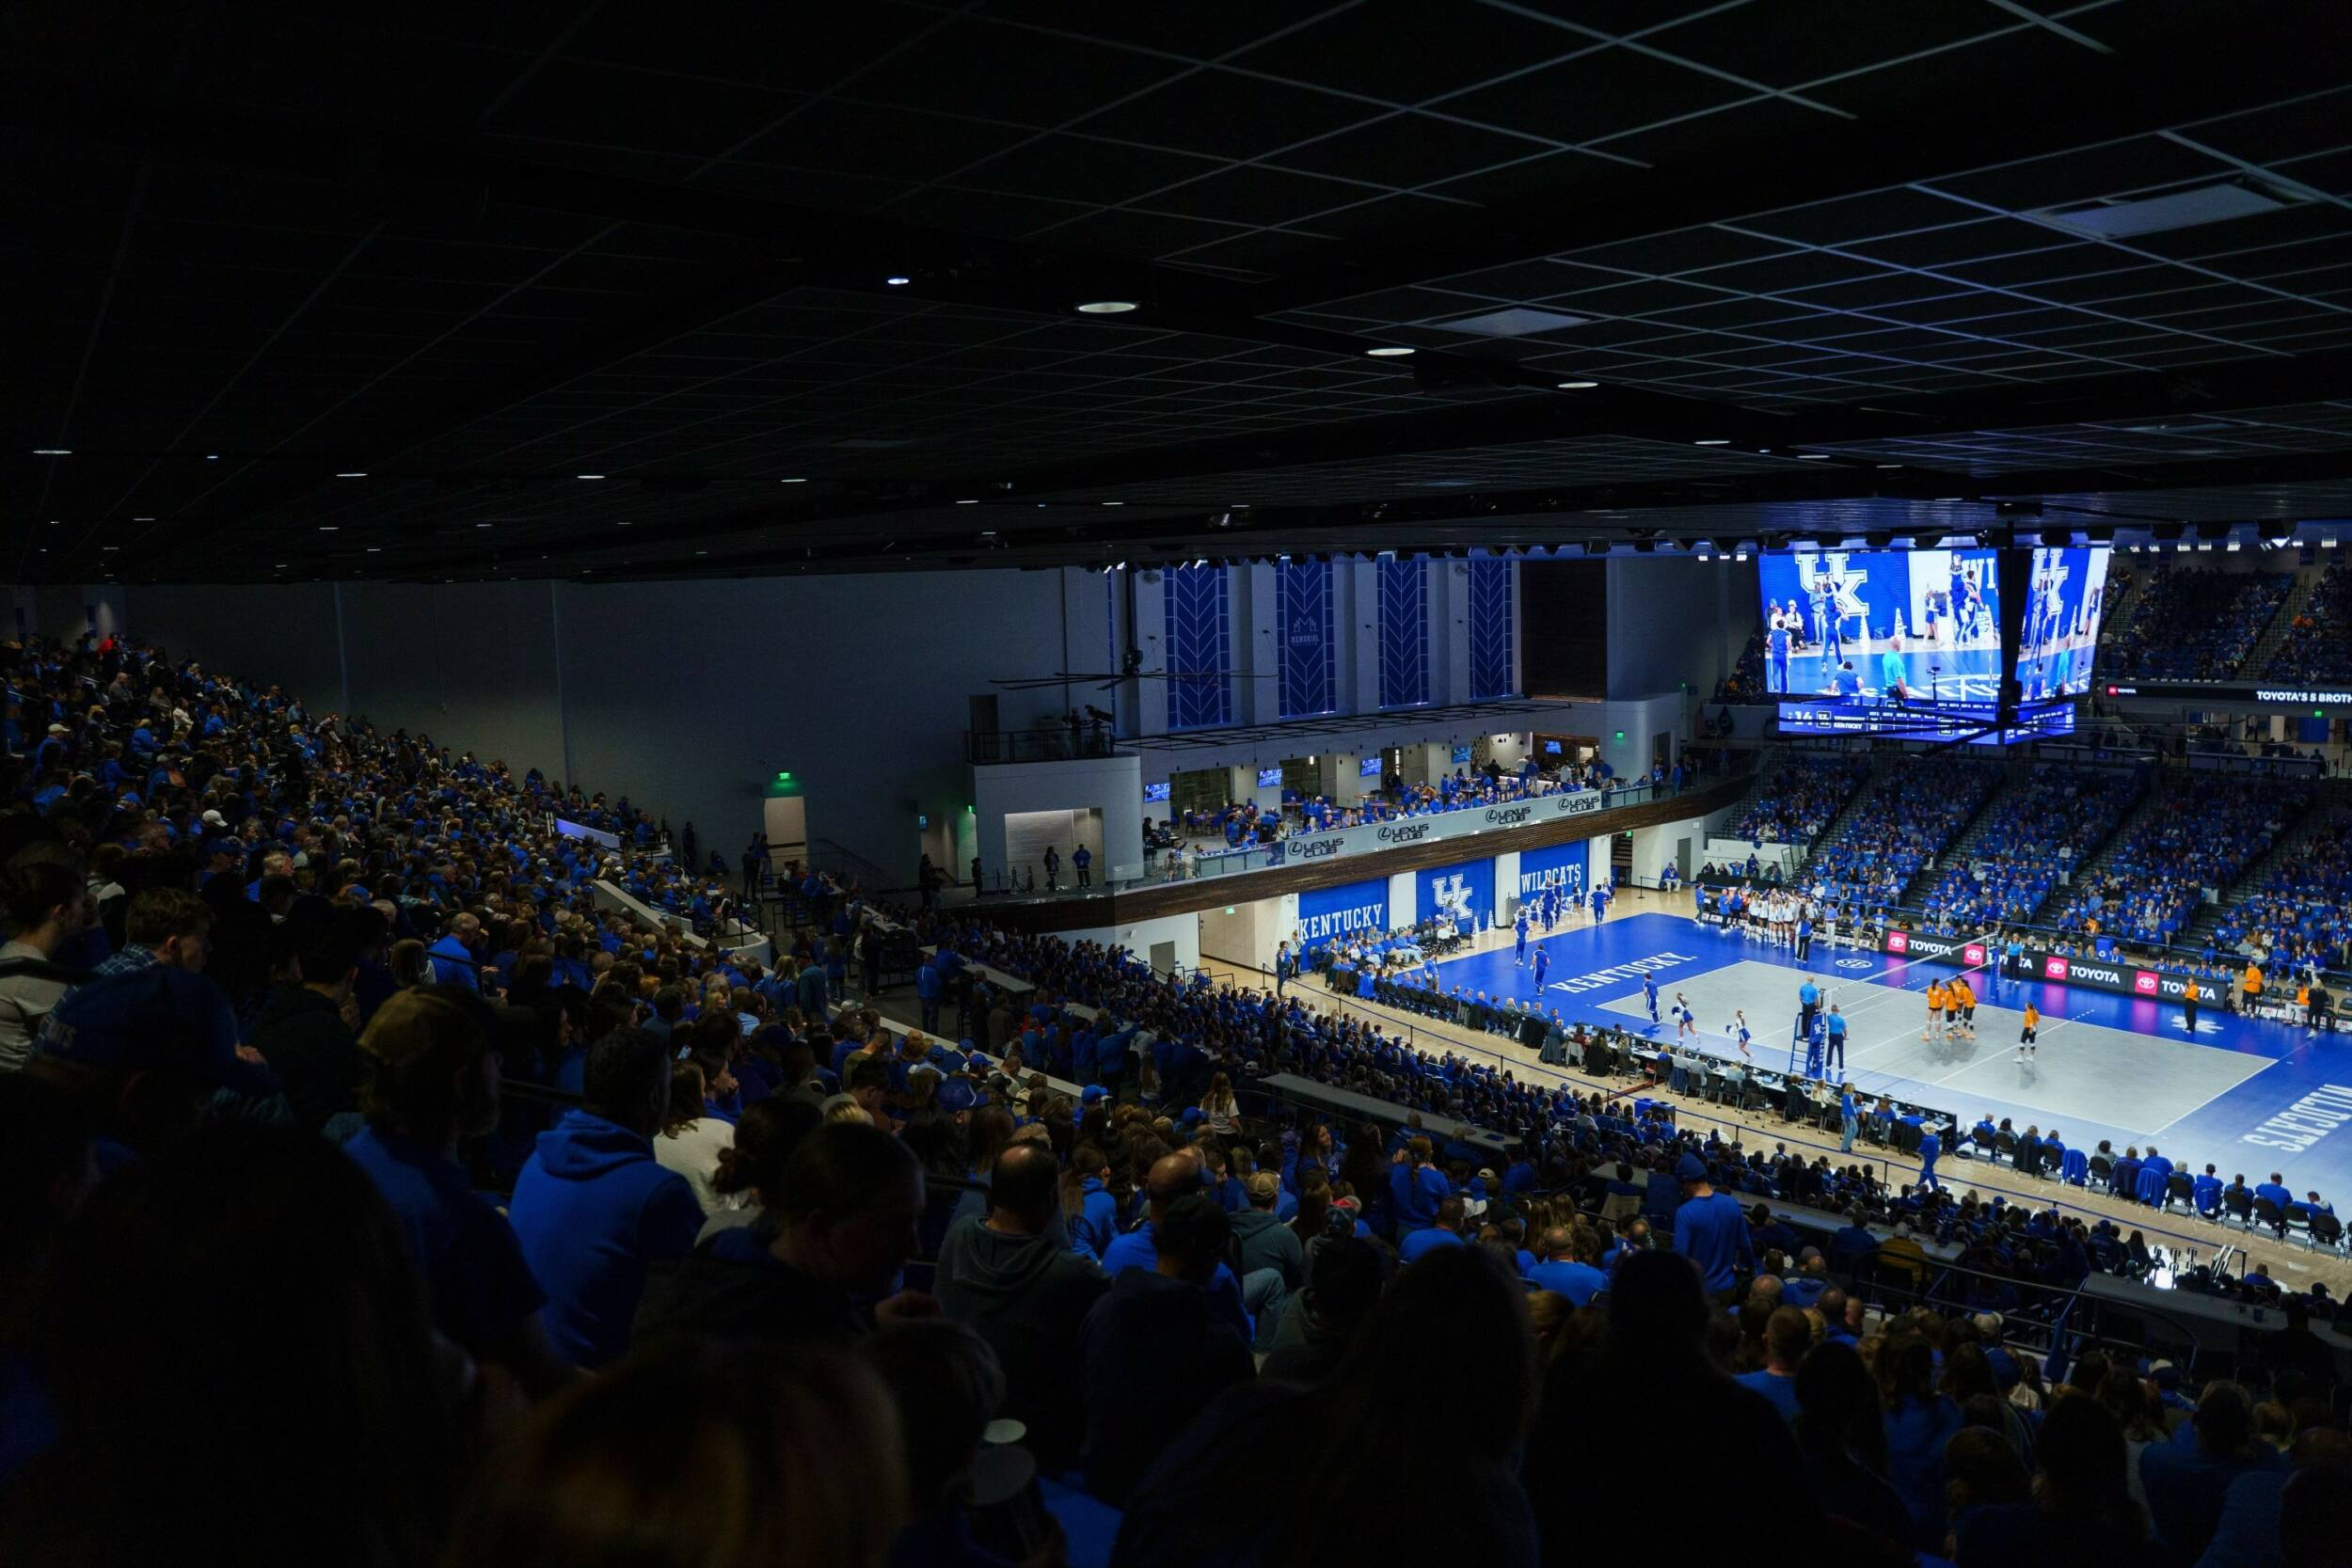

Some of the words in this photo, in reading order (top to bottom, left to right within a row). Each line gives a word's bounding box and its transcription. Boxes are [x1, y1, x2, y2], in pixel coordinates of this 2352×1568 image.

[2256, 690, 2308, 702] TOYOTA'S
[2310, 693, 2316, 703] 5
[1570, 796, 1599, 807] LEXUS
[1498, 806, 1531, 817] LEXUS
[1570, 803, 1595, 813] CLUB
[1499, 814, 1526, 824] CLUB
[1392, 823, 1429, 835] LEXUS
[1392, 832, 1423, 843] CLUB
[1304, 838, 1343, 849] LEXUS
[1304, 847, 1337, 858] CLUB
[1299, 903, 1382, 940] KENTUCKY
[1909, 940, 1952, 956] TOYOTA
[1548, 952, 1693, 993] KENTUCKY
[2070, 966, 2120, 984] TOYOTA
[2162, 980, 2217, 1000] TOYTA
